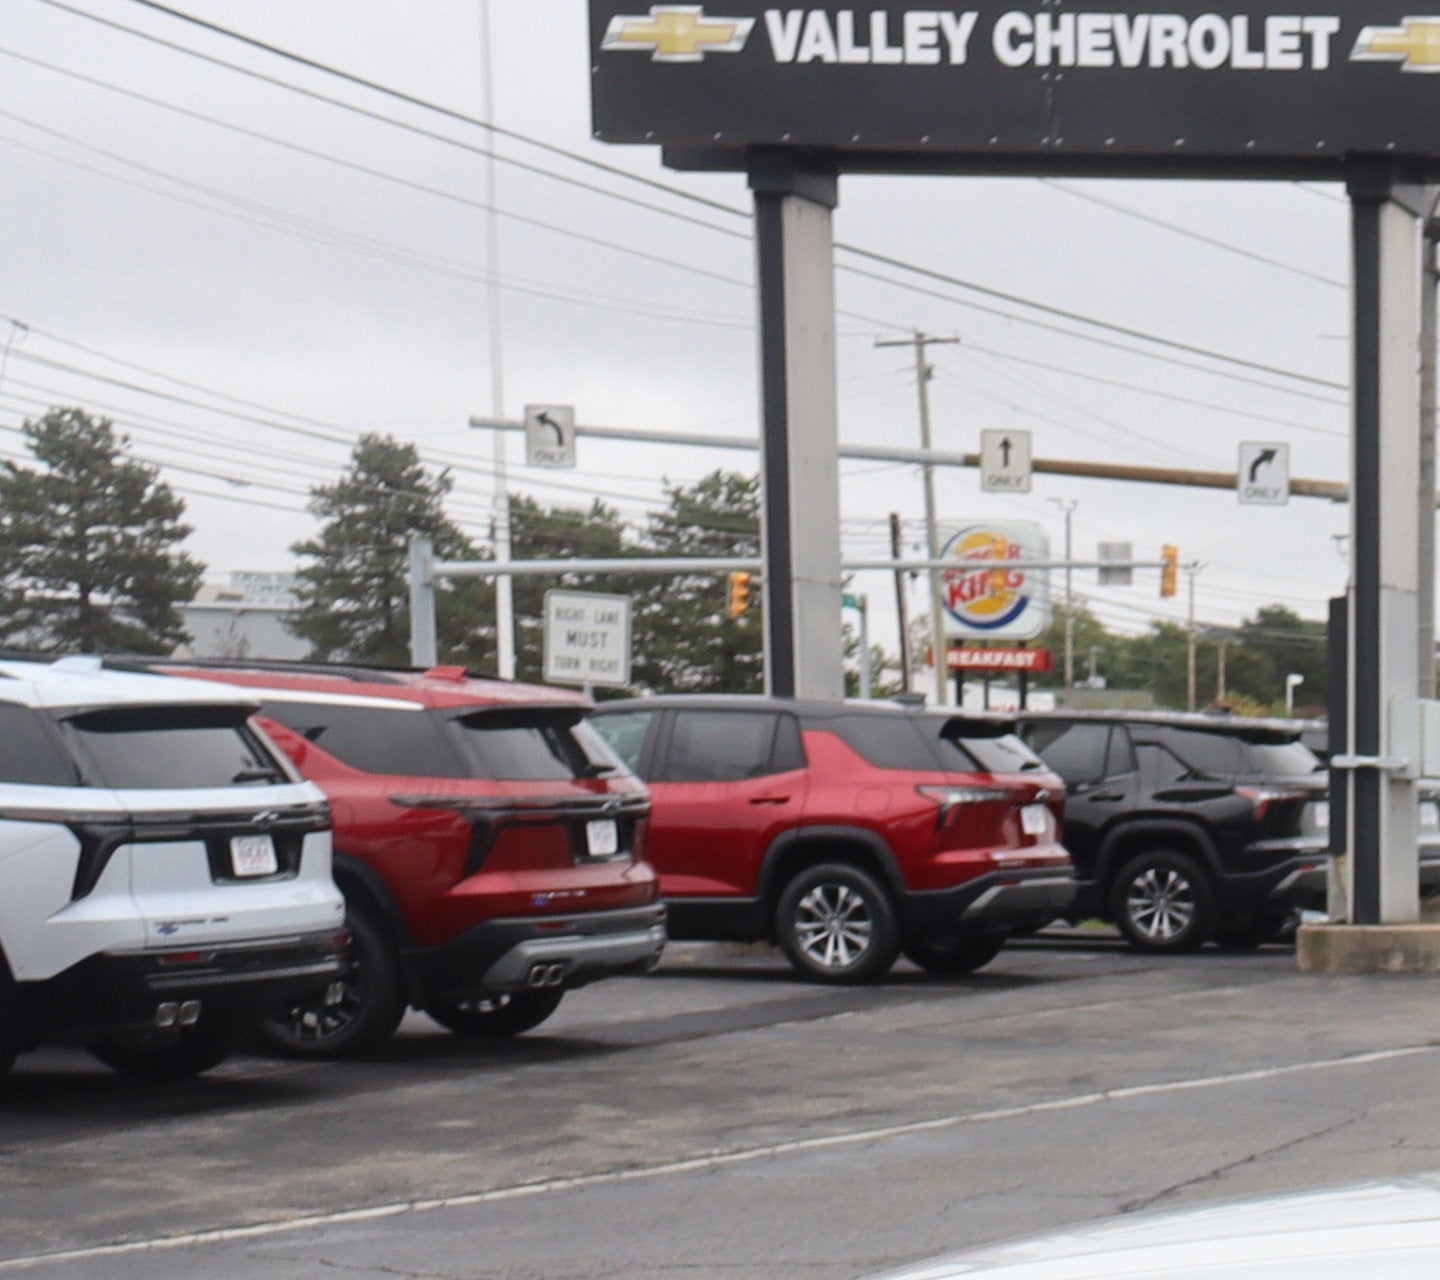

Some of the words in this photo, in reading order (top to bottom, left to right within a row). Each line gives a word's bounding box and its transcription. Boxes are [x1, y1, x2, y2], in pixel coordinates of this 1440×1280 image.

[764, 8, 979, 65] VALLEY
[992, 10, 1340, 70] CHEVROLET
[987, 474, 1022, 488] ONLY
[1244, 486, 1281, 500] ONLY
[555, 607, 586, 620] RIGHT
[594, 611, 620, 625] LANE
[566, 627, 608, 648] MUST
[589, 658, 619, 673] RIGHT
[946, 651, 1037, 667] REAKFAST
